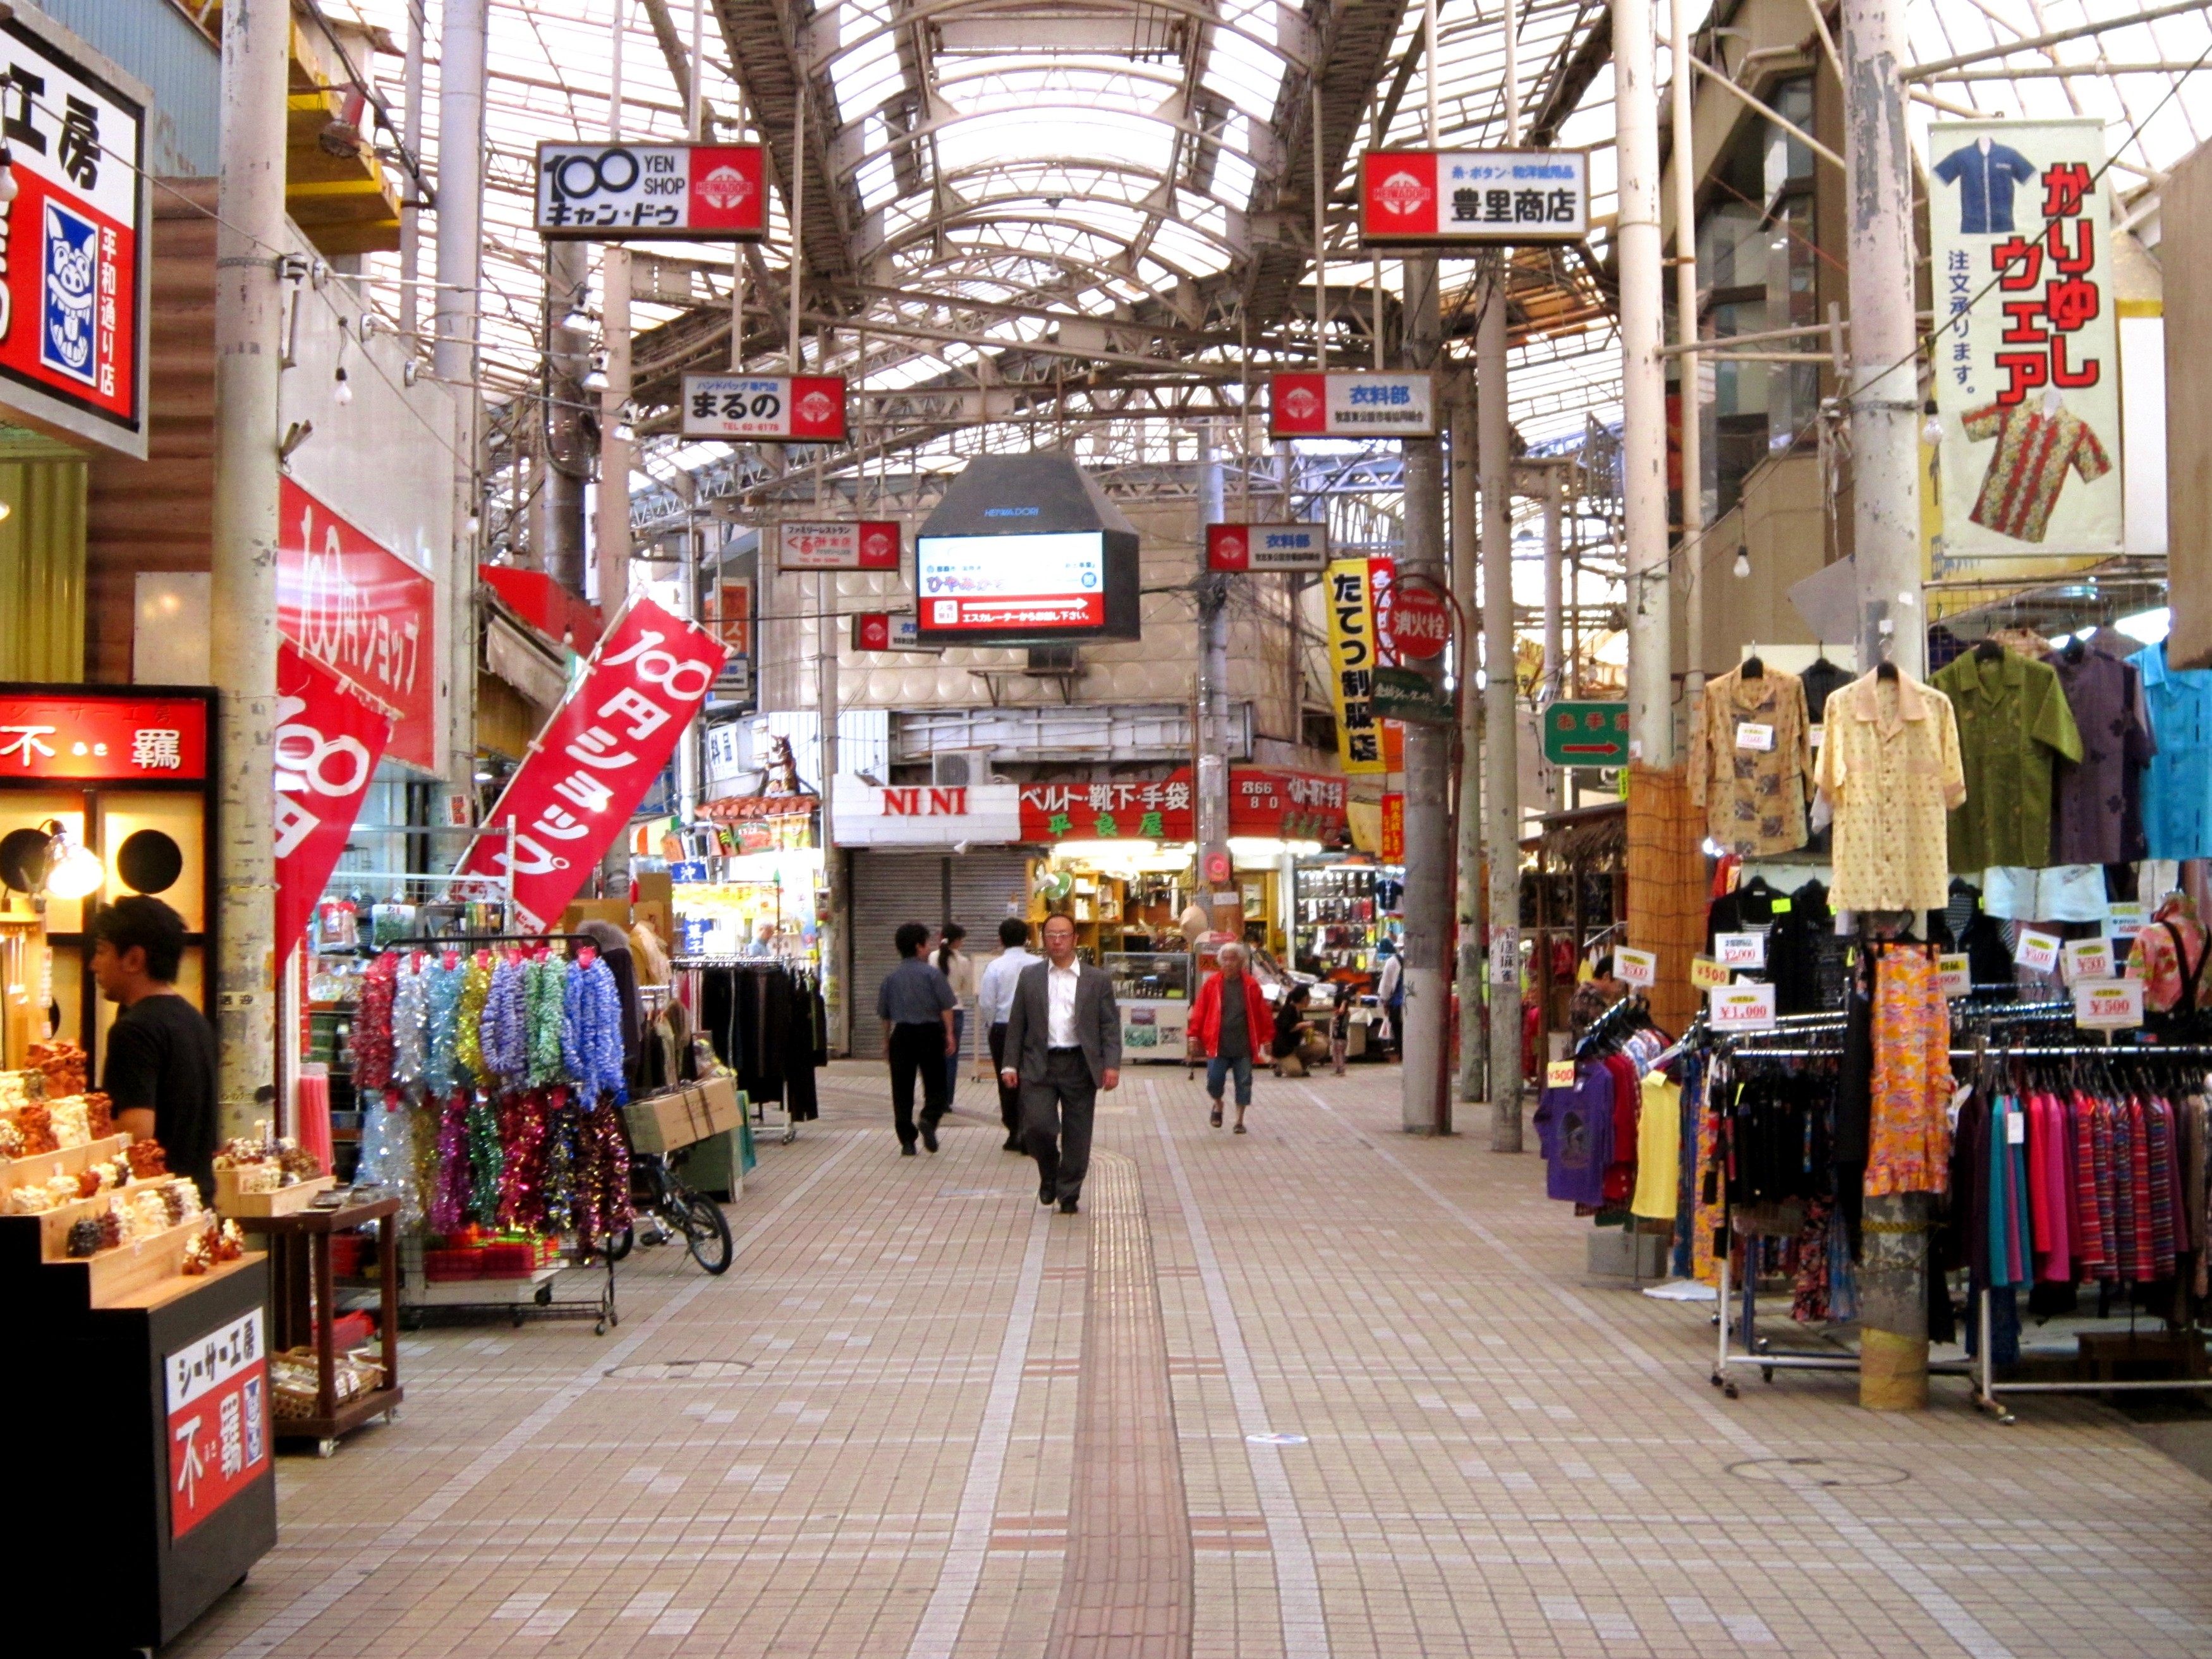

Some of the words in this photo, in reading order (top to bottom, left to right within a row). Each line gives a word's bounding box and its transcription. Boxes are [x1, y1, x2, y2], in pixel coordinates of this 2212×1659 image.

[9, 62, 102, 190] 工房
[544, 148, 639, 202] 100
[645, 156, 674, 172] YEN
[644, 178, 685, 195] SHOP
[1451, 187, 1576, 222] 豊里商店
[2041, 162, 2100, 388] かりゆし
[100, 226, 117, 397] 平和通り店
[1948, 250, 1976, 394] 注文承ります。
[697, 381, 778, 391] ハンドバッグ専門店
[1349, 385, 1410, 405] 衣料部
[692, 392, 781, 420] まるの
[985, 507, 1039, 517] HEIWADORI
[297, 504, 418, 695] 100円ショップ
[1394, 609, 1445, 640] 消火栓
[0, 726, 56, 767] 不
[492, 629, 712, 875] 100円ショップ
[1020, 782, 1190, 811] ベルト・靴下・手袋
[1047, 811, 1165, 837] 平良屋
[1697, 966, 1726, 983] ¥500
[1720, 1006, 1767, 1019] ¥1,000
[178, 1318, 255, 1398] シーサー工房
[176, 1414, 202, 1509] 不
